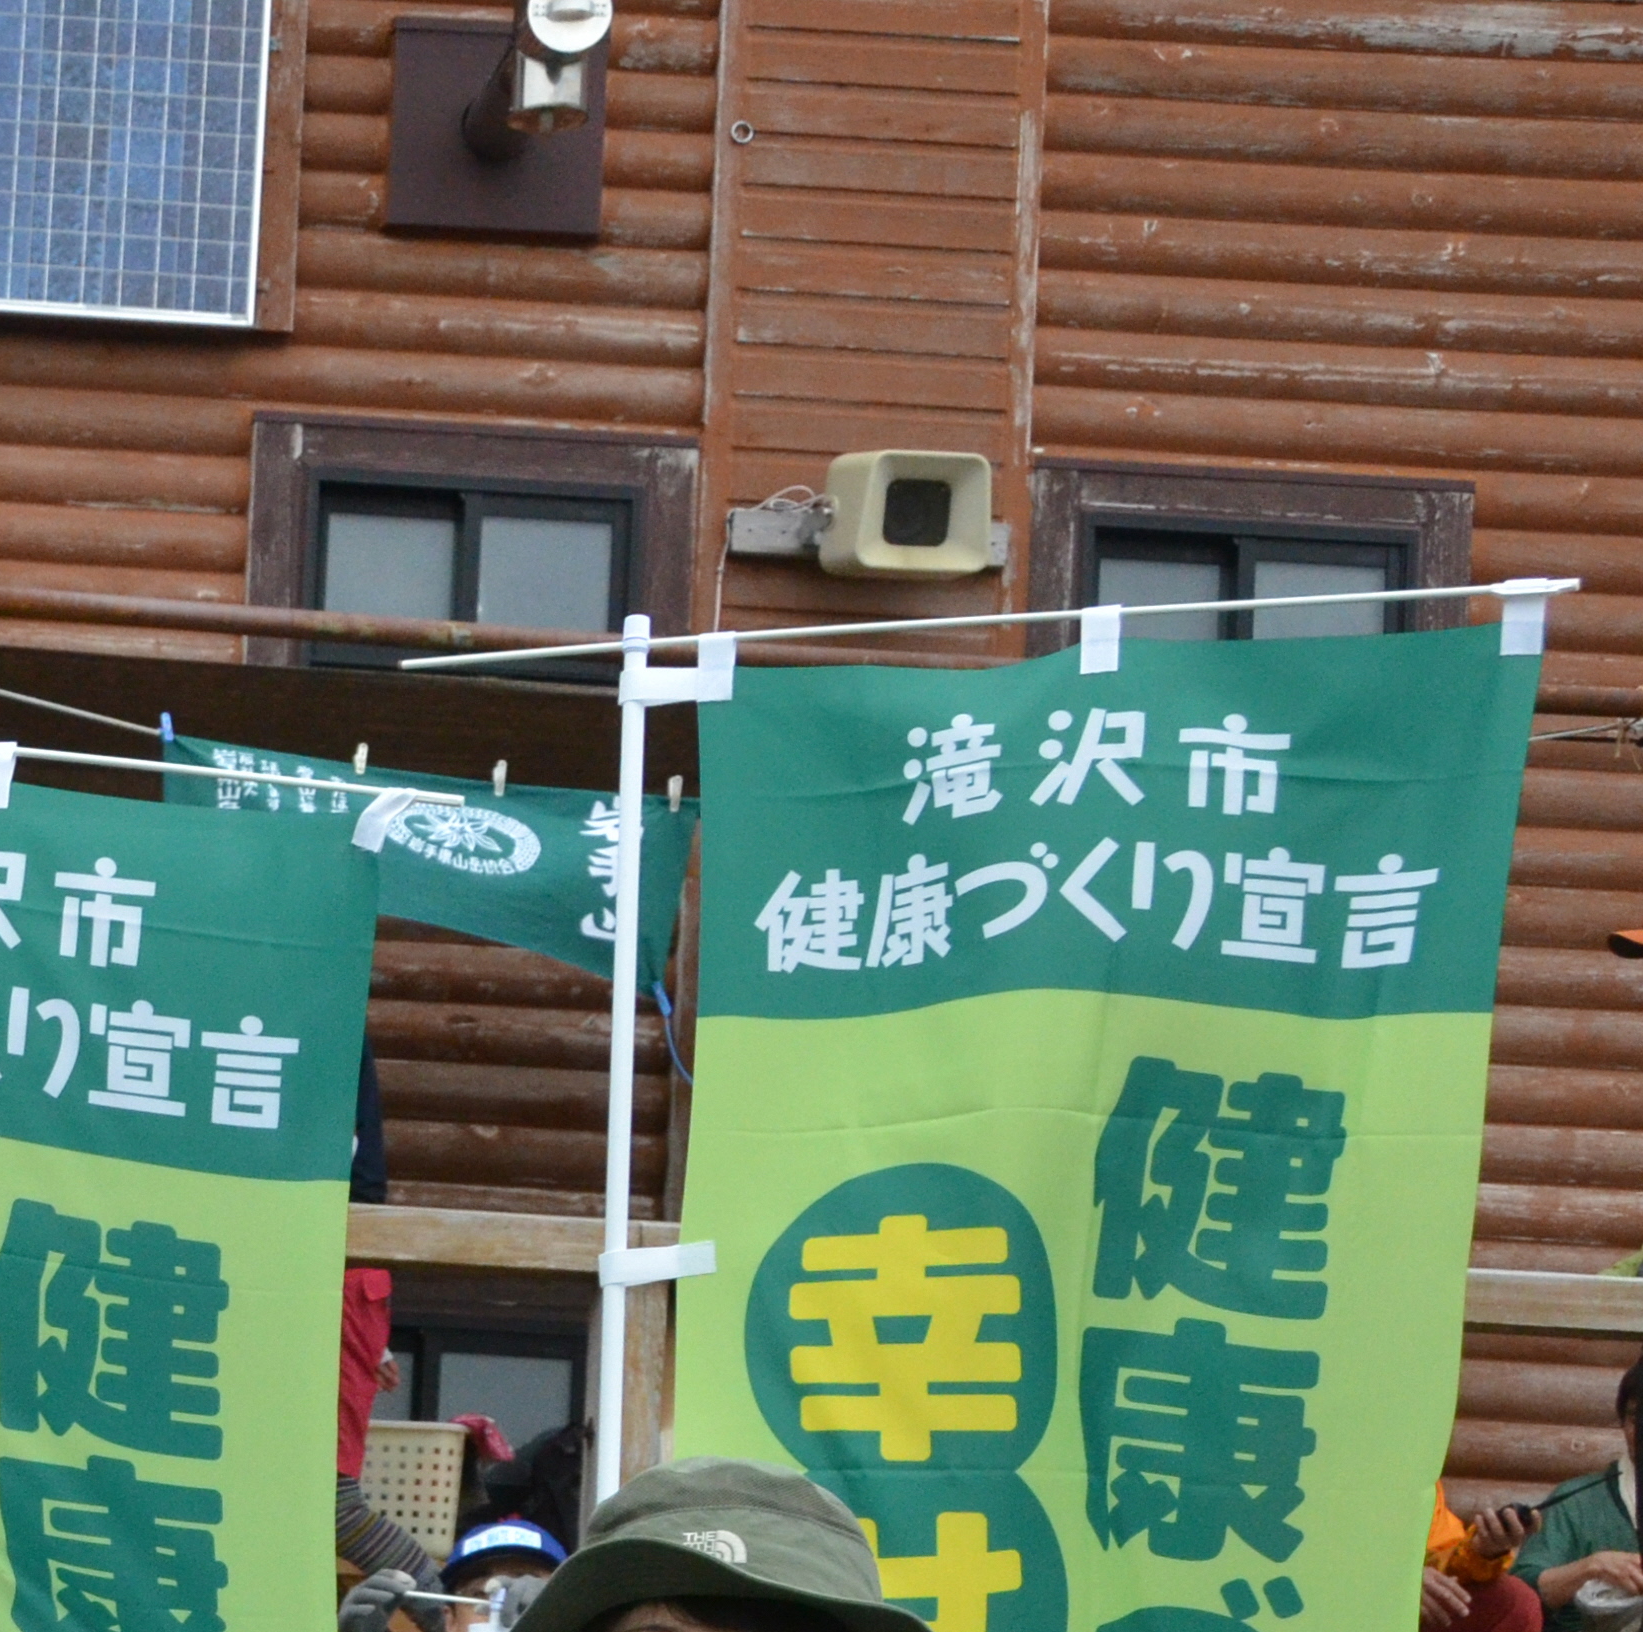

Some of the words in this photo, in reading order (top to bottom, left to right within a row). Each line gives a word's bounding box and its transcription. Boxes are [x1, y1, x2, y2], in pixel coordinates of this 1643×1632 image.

[902, 708, 1291, 825] 滝沢市
[754, 837, 1440, 975] 健康づくり宣言
[683, 1531, 716, 1542] THE
